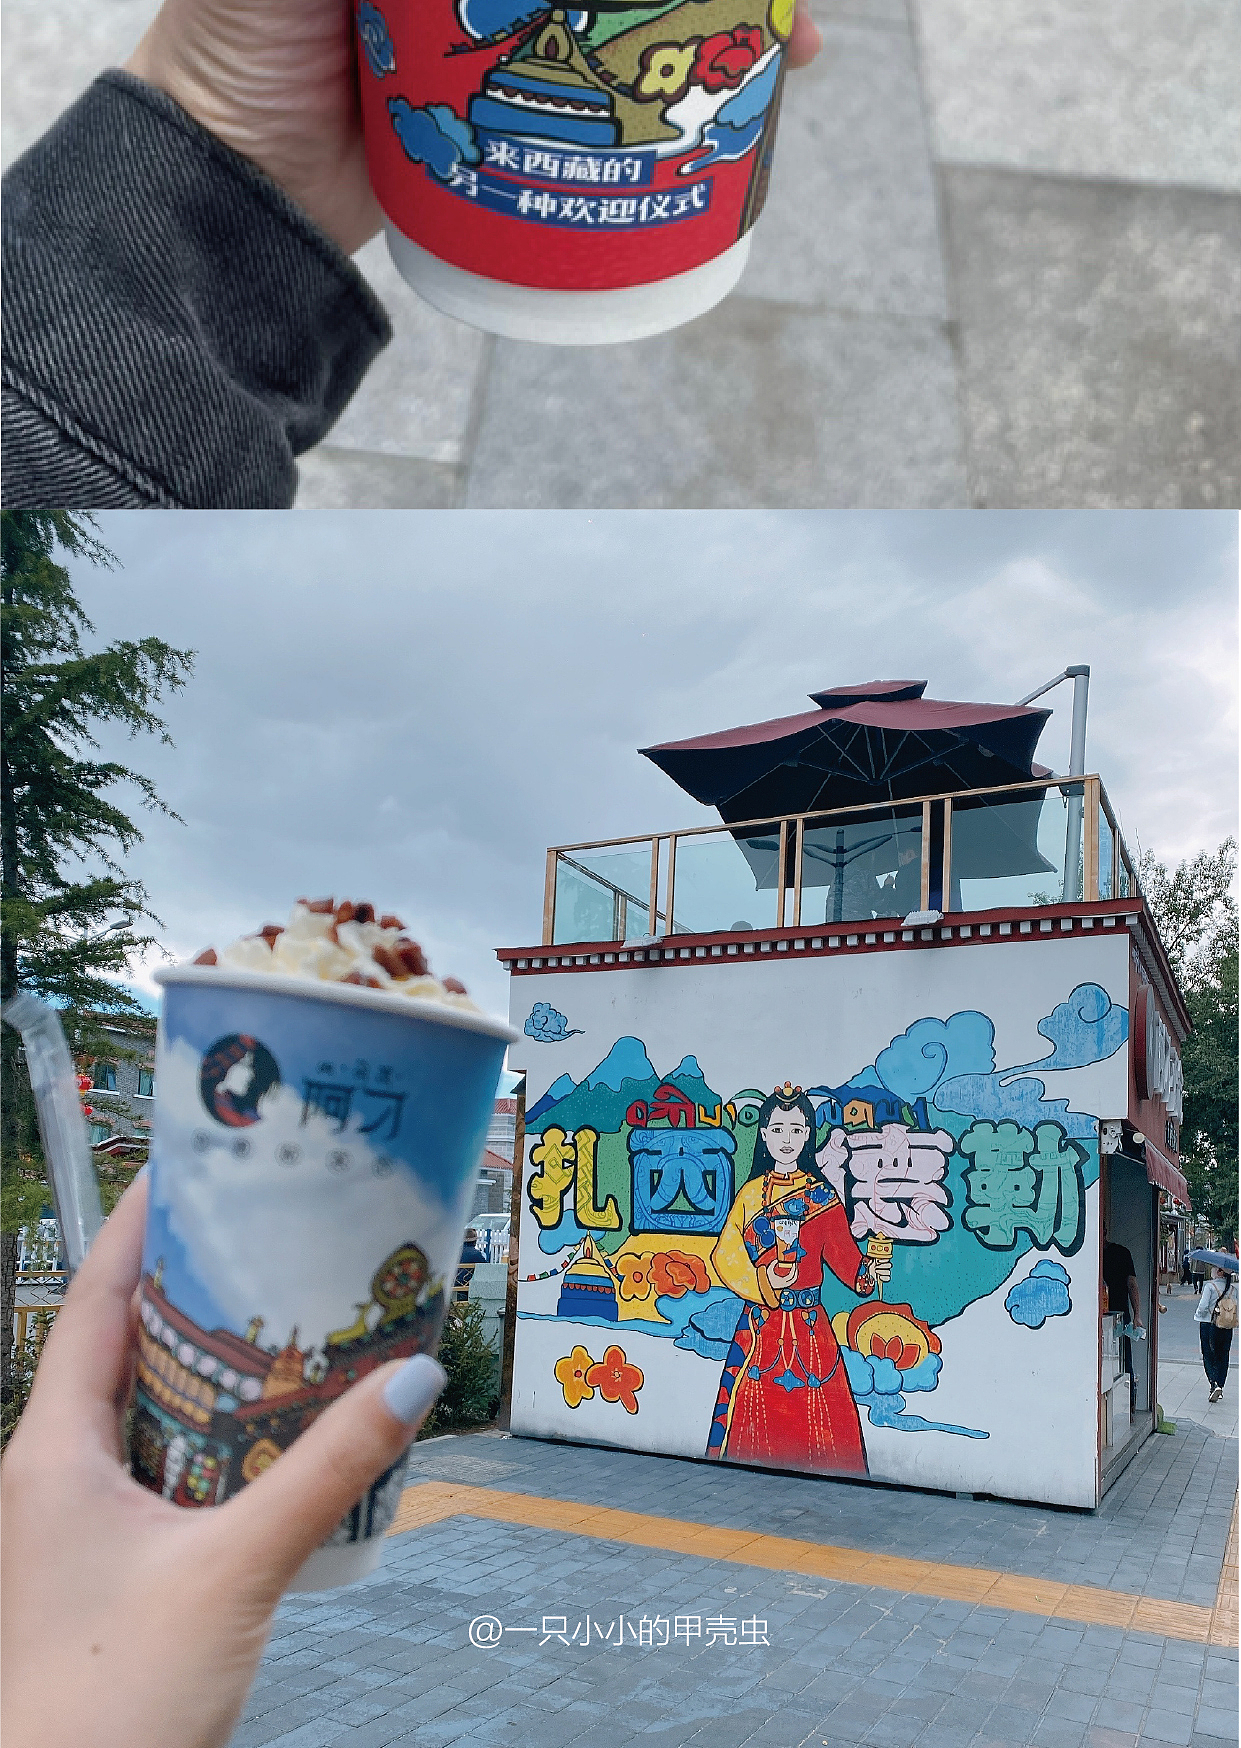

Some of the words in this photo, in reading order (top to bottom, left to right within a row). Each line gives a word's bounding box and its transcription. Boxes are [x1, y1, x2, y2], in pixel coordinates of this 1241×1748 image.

[448, 161, 707, 224] 另一种欢迎仪式
[484, 138, 643, 184] 来西藏的
[299, 1076, 408, 1143] 阿刁
[526, 1123, 739, 1236] 扎西
[814, 1118, 1092, 1251] 德勒
